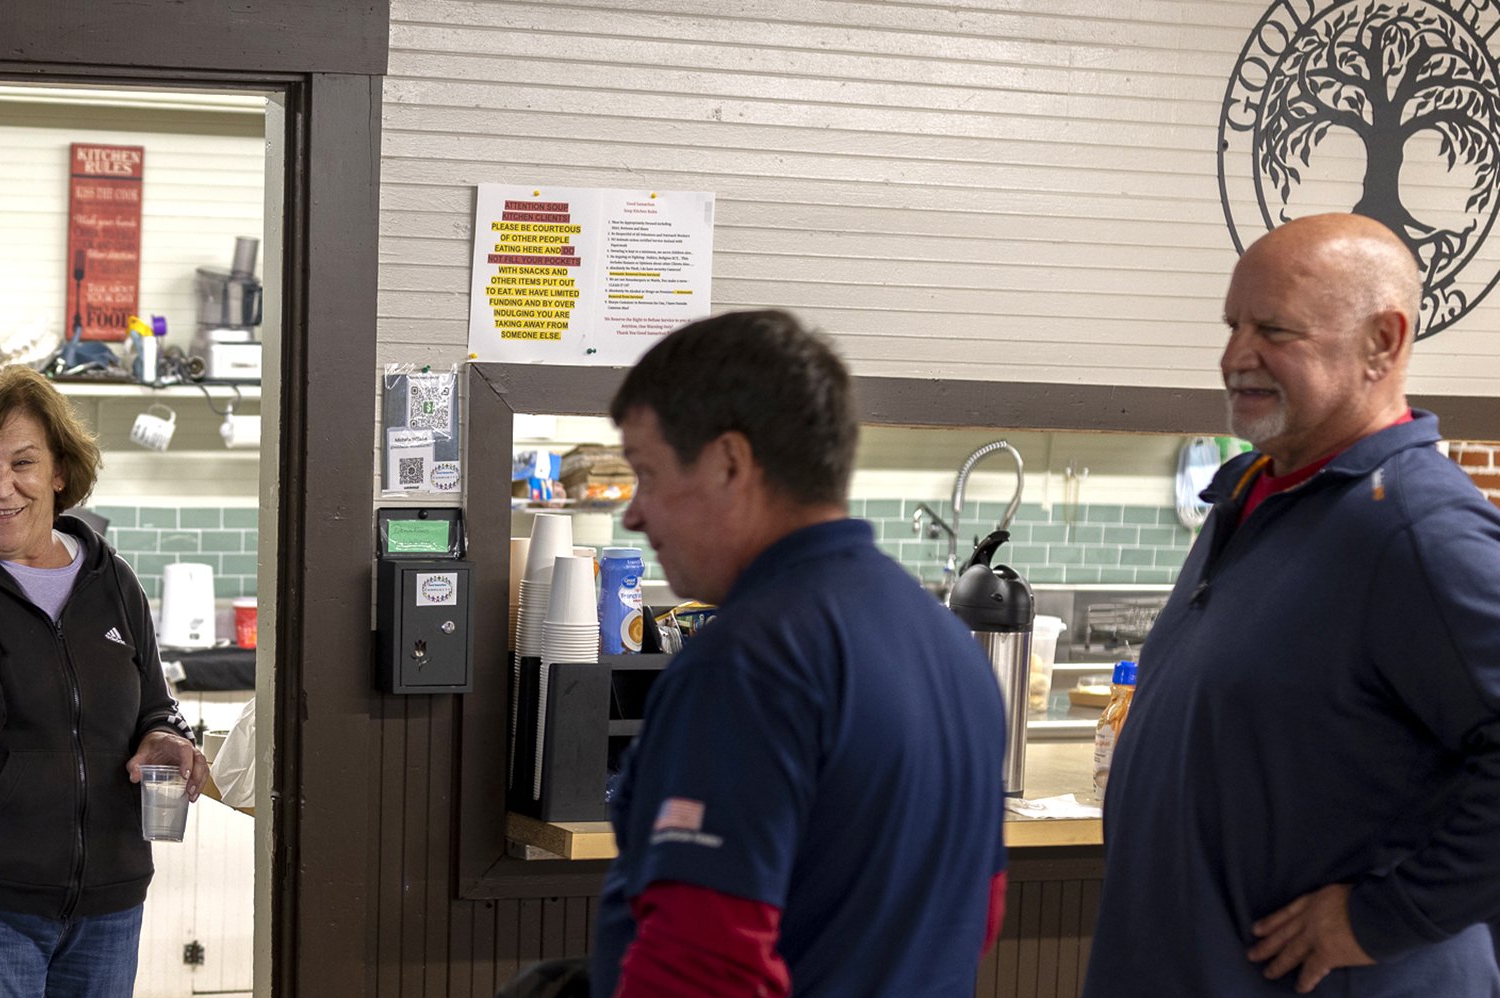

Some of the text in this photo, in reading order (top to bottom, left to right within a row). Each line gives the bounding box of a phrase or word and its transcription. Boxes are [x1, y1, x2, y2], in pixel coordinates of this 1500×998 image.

[77, 148, 141, 163] KITCHEN
[84, 161, 133, 175] RULES
[505, 201, 569, 211] ATTENTION SOUP
[491, 223, 519, 231] PLEASE
[532, 225, 581, 233] COURTEOUS
[545, 246, 561, 254] AND
[488, 255, 505, 263] NOT
[522, 256, 543, 264] YOUR
[545, 257, 581, 265] POCKETS
[519, 267, 550, 275] SNACKS
[491, 277, 516, 285] OTHER
[518, 278, 540, 286] ITEMS
[560, 279, 575, 287] OUT
[498, 288, 513, 296] EAT.
[529, 289, 548, 297] HAVE
[489, 298, 523, 307] FUNDING
[524, 299, 540, 307] AND
[555, 300, 575, 308] OVER
[494, 309, 570, 319] INDULGING YOU ARE
[495, 320, 568, 329] TAKING AWAY FROM
[501, 331, 561, 340] SOMEONE ELSE.
